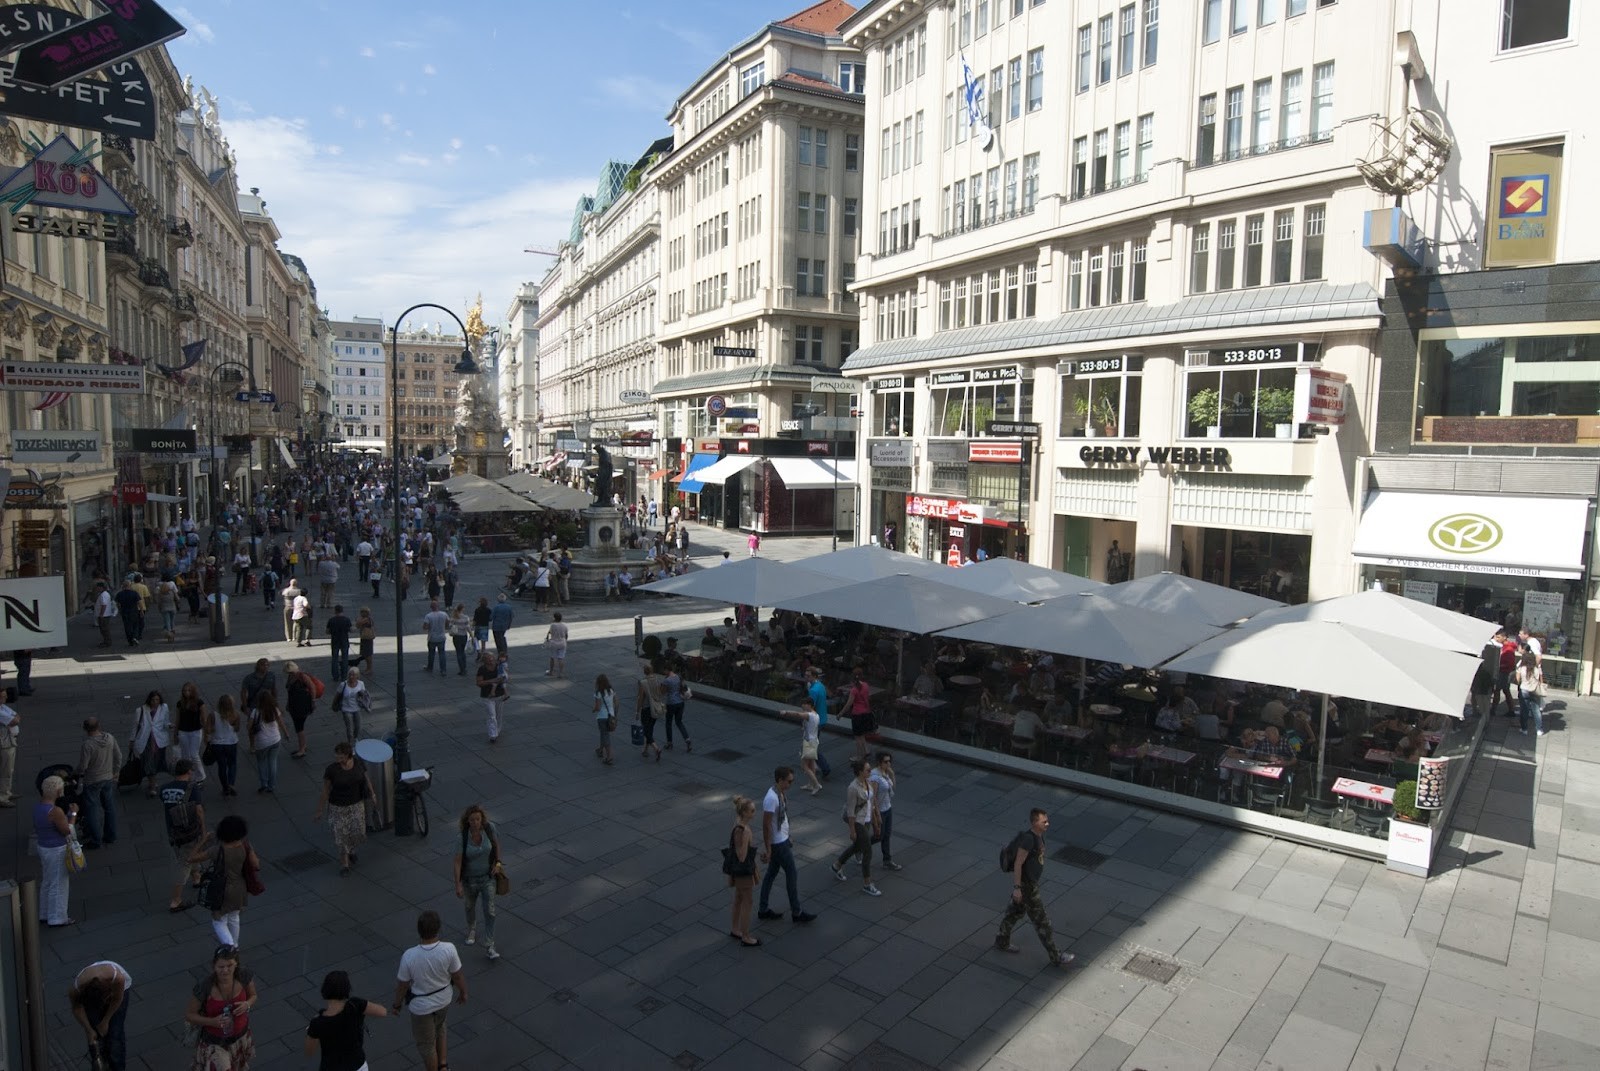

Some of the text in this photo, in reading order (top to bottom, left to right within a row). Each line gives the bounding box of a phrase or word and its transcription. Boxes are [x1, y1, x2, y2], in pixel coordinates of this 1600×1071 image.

[69, 24, 119, 53] BAR
[19, 366, 64, 374] GALERIE
[992, 370, 997, 378] &
[7, 378, 140, 389] SINDBADS REISEN
[991, 424, 1013, 433] GERRY
[1079, 445, 1229, 465] GERRY WEBER
[7, 488, 42, 496] OSSIL
[922, 506, 949, 518] SALE
[1396, 558, 1419, 567] YVES
[1463, 564, 1506, 574] Kosmetik
[1508, 567, 1541, 576] Institut
